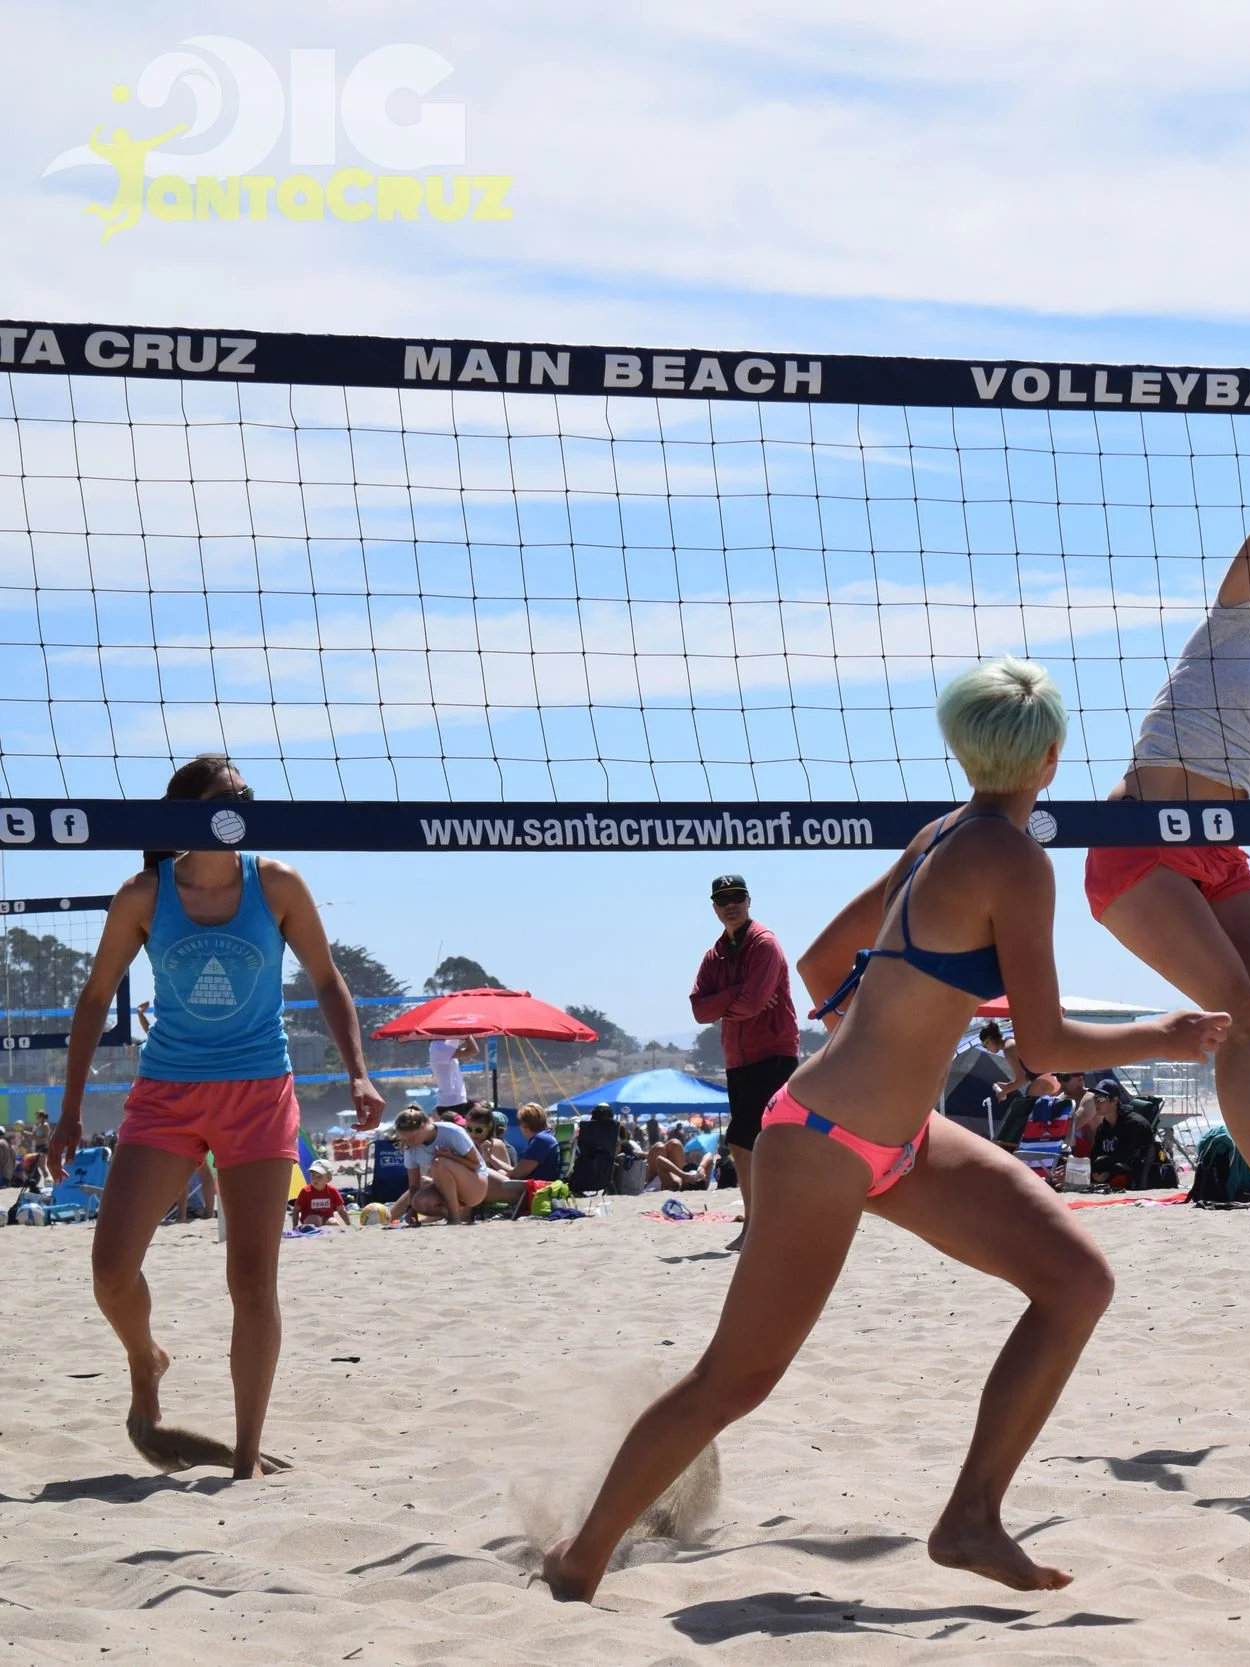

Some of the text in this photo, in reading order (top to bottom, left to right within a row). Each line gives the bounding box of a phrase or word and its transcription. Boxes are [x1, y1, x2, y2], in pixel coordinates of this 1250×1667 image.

[84, 331, 257, 374] CRUZ
[404, 345, 822, 394] MAIN BEACH
[420, 812, 873, 846] www.santacruzwharf.com
